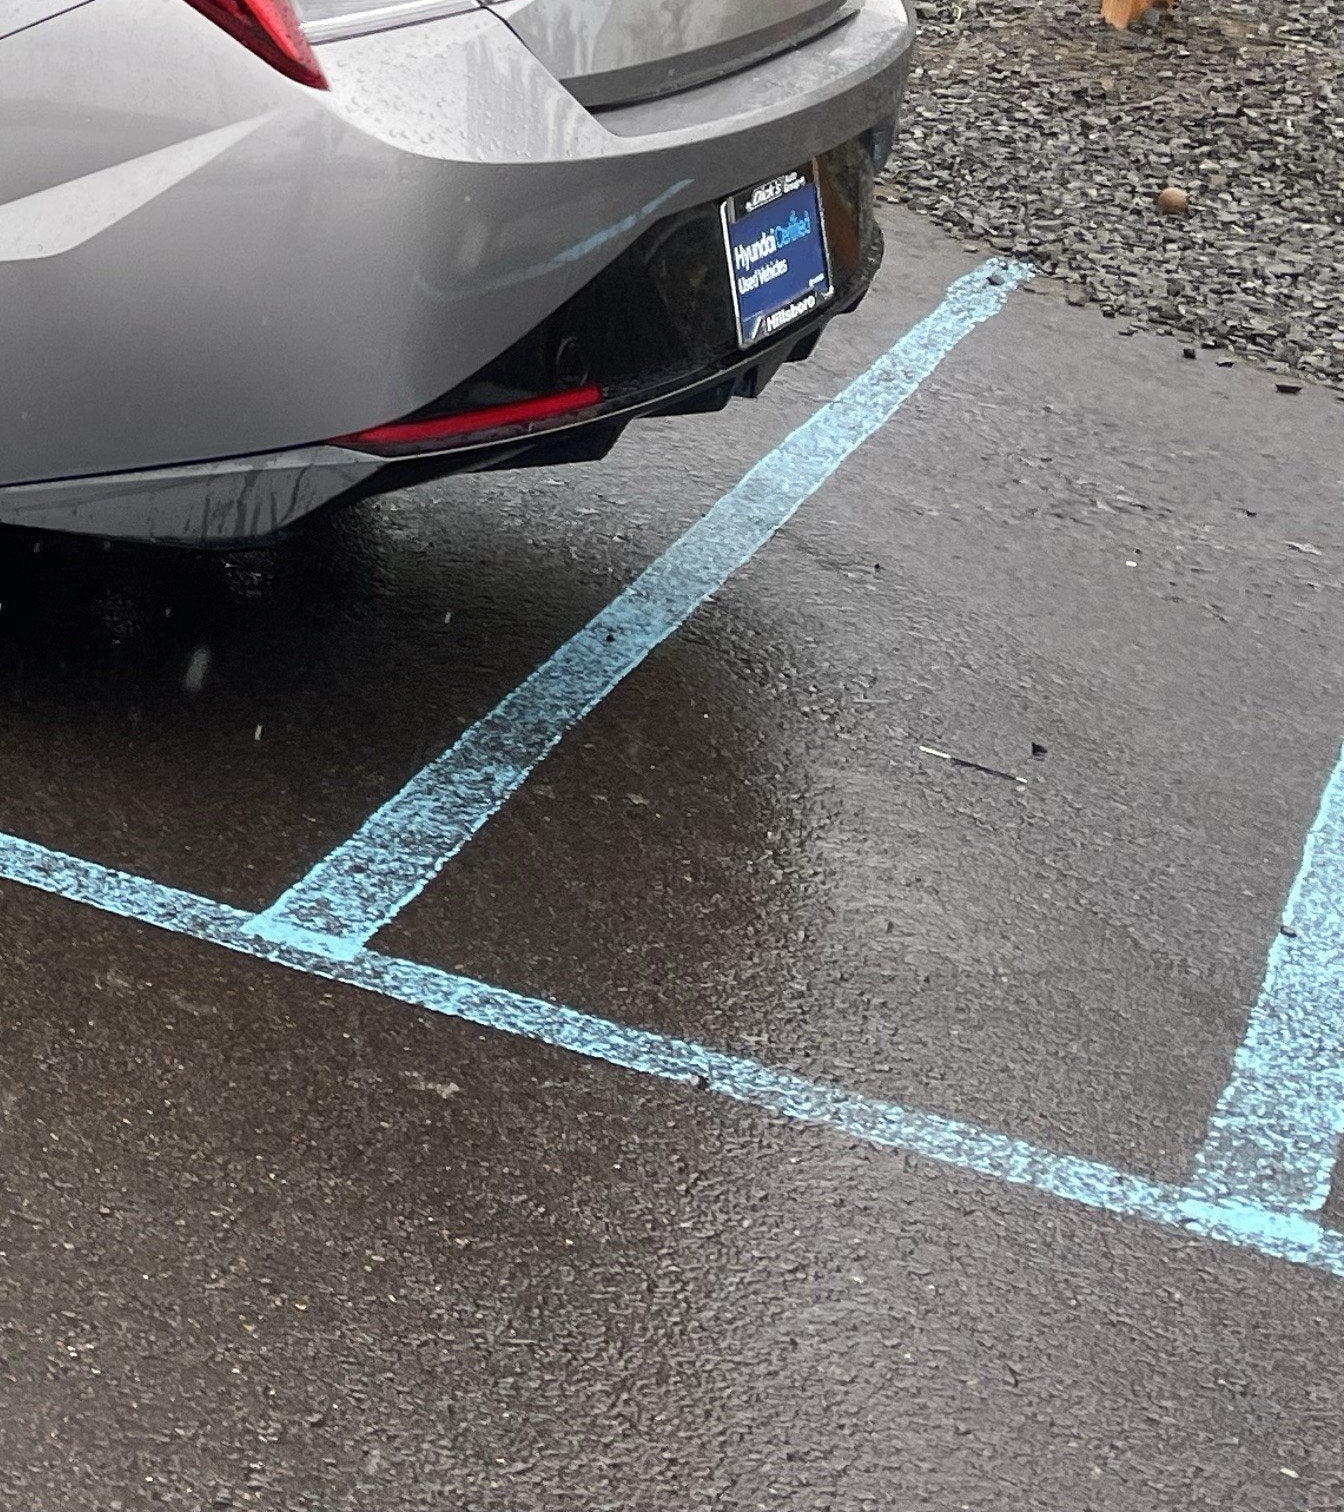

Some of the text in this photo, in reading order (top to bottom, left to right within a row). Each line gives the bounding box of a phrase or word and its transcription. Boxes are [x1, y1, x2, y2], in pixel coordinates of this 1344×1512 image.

[734, 227, 777, 271] Hyundai
[738, 270, 759, 295] Used
[766, 295, 816, 332] Hillsboro
